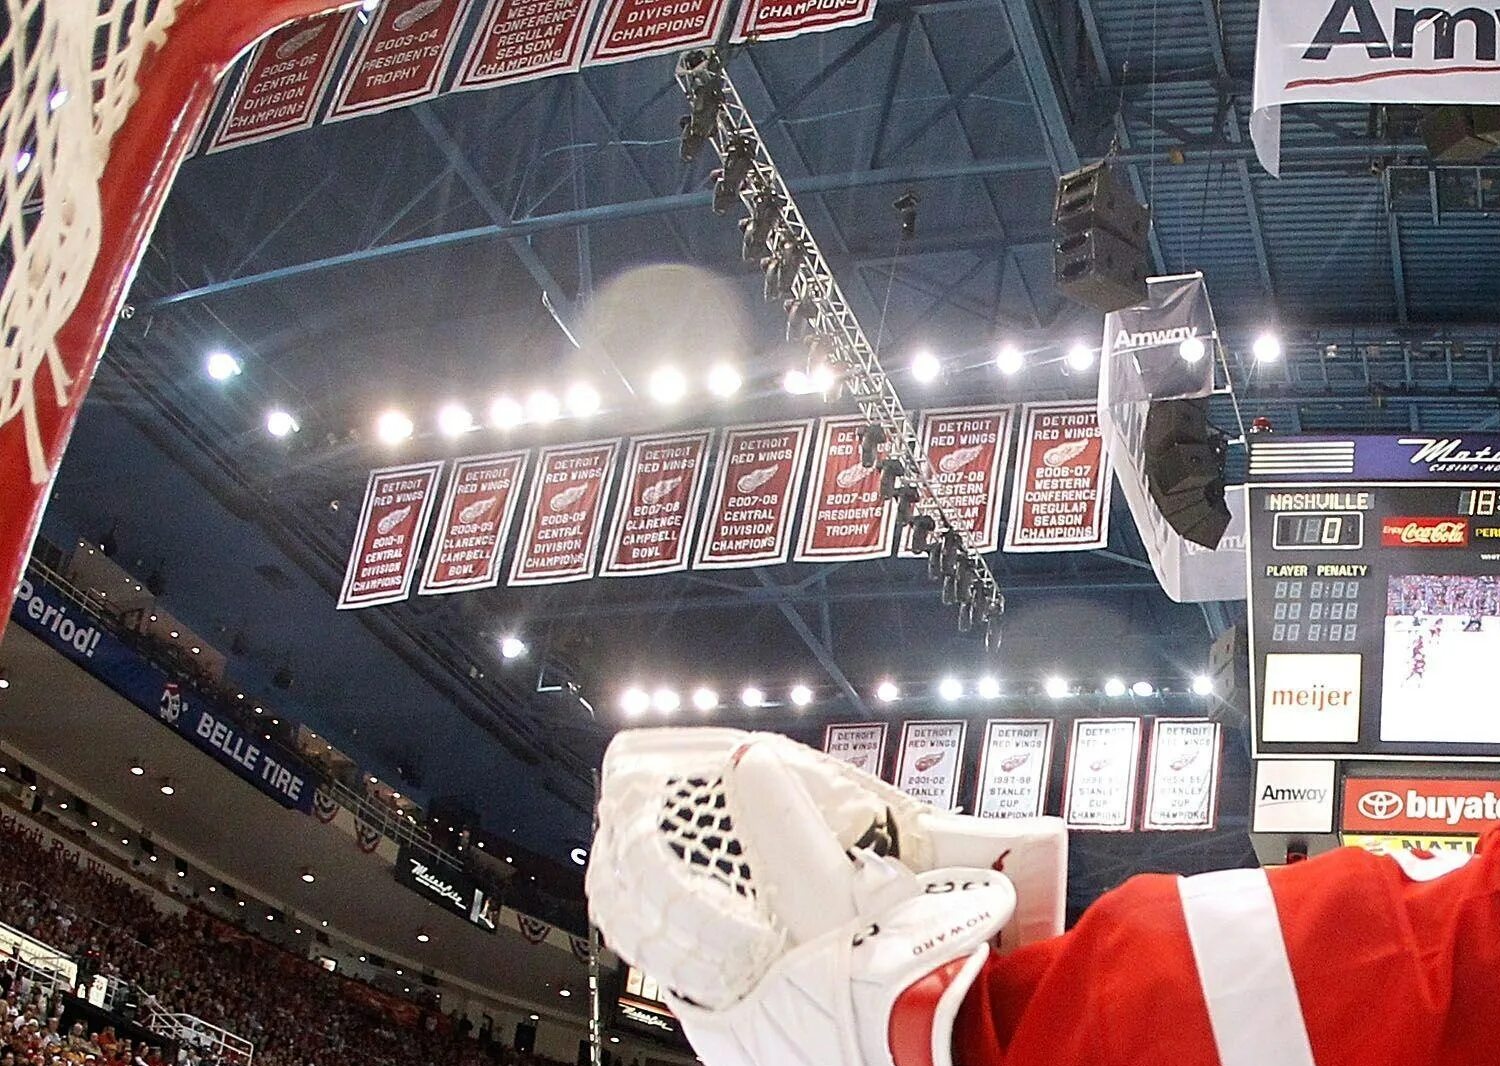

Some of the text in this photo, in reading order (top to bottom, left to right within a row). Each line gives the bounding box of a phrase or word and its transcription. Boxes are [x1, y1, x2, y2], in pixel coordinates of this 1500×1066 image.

[626, 1, 702, 24] DIVISION
[497, 24, 564, 48] REGULAR
[612, 15, 706, 42] CHAMPIONS
[496, 38, 556, 60] SEASON
[477, 49, 562, 76] CHAMPIONS
[252, 69, 309, 95] CENTRAL
[365, 65, 421, 88] TROPHY
[243, 85, 307, 111] DIVISION
[229, 101, 305, 129] CHAMPIONS
[1114, 326, 1198, 349] Amway
[938, 419, 993, 433] DETROIT
[1041, 413, 1098, 427] DETROIT
[930, 432, 996, 447] RED WINGS
[1034, 426, 1102, 441] RED WINGS
[739, 436, 790, 451] DETROIT
[554, 456, 600, 470] DETROIT
[731, 448, 793, 465] RED WINGS
[545, 467, 602, 484] RED WINGS
[1034, 477, 1091, 491] WESTERN
[727, 493, 778, 507] 2007-08
[1025, 490, 1097, 504] CONFERENCE
[1269, 493, 1370, 511] NASHVILLE
[723, 508, 776, 522] CENTRAL
[1032, 501, 1088, 515] REGULAR
[625, 515, 683, 531] CLARENCE
[1034, 514, 1083, 526] SEASON
[537, 524, 584, 540] CENTRAL
[720, 523, 773, 537] DIVISION
[825, 523, 870, 537] TROPHY
[1020, 526, 1094, 540] CHAMPIONS
[443, 534, 496, 549] CLARENCE
[622, 530, 678, 546] CAMPBELL
[711, 536, 775, 552] CHAMPIONS
[533, 539, 582, 554] DIVISION
[631, 546, 662, 559] BOWL
[365, 548, 404, 564] CENTRAL
[440, 549, 492, 564] CAMPBELL
[448, 564, 475, 577] BOWL
[1266, 564, 1369, 577] PLAYER PENALTY
[1271, 684, 1353, 712] meijer
[837, 731, 875, 741] DETROIT
[913, 728, 954, 738] DETROIT
[997, 728, 1039, 738] DETROIT
[908, 739, 957, 748] RED WINGS
[196, 711, 304, 802] BELLE TIRE
[1261, 783, 1328, 805] Amway
[999, 798, 1020, 808] CUP
[0, 806, 44, 844] etroit
